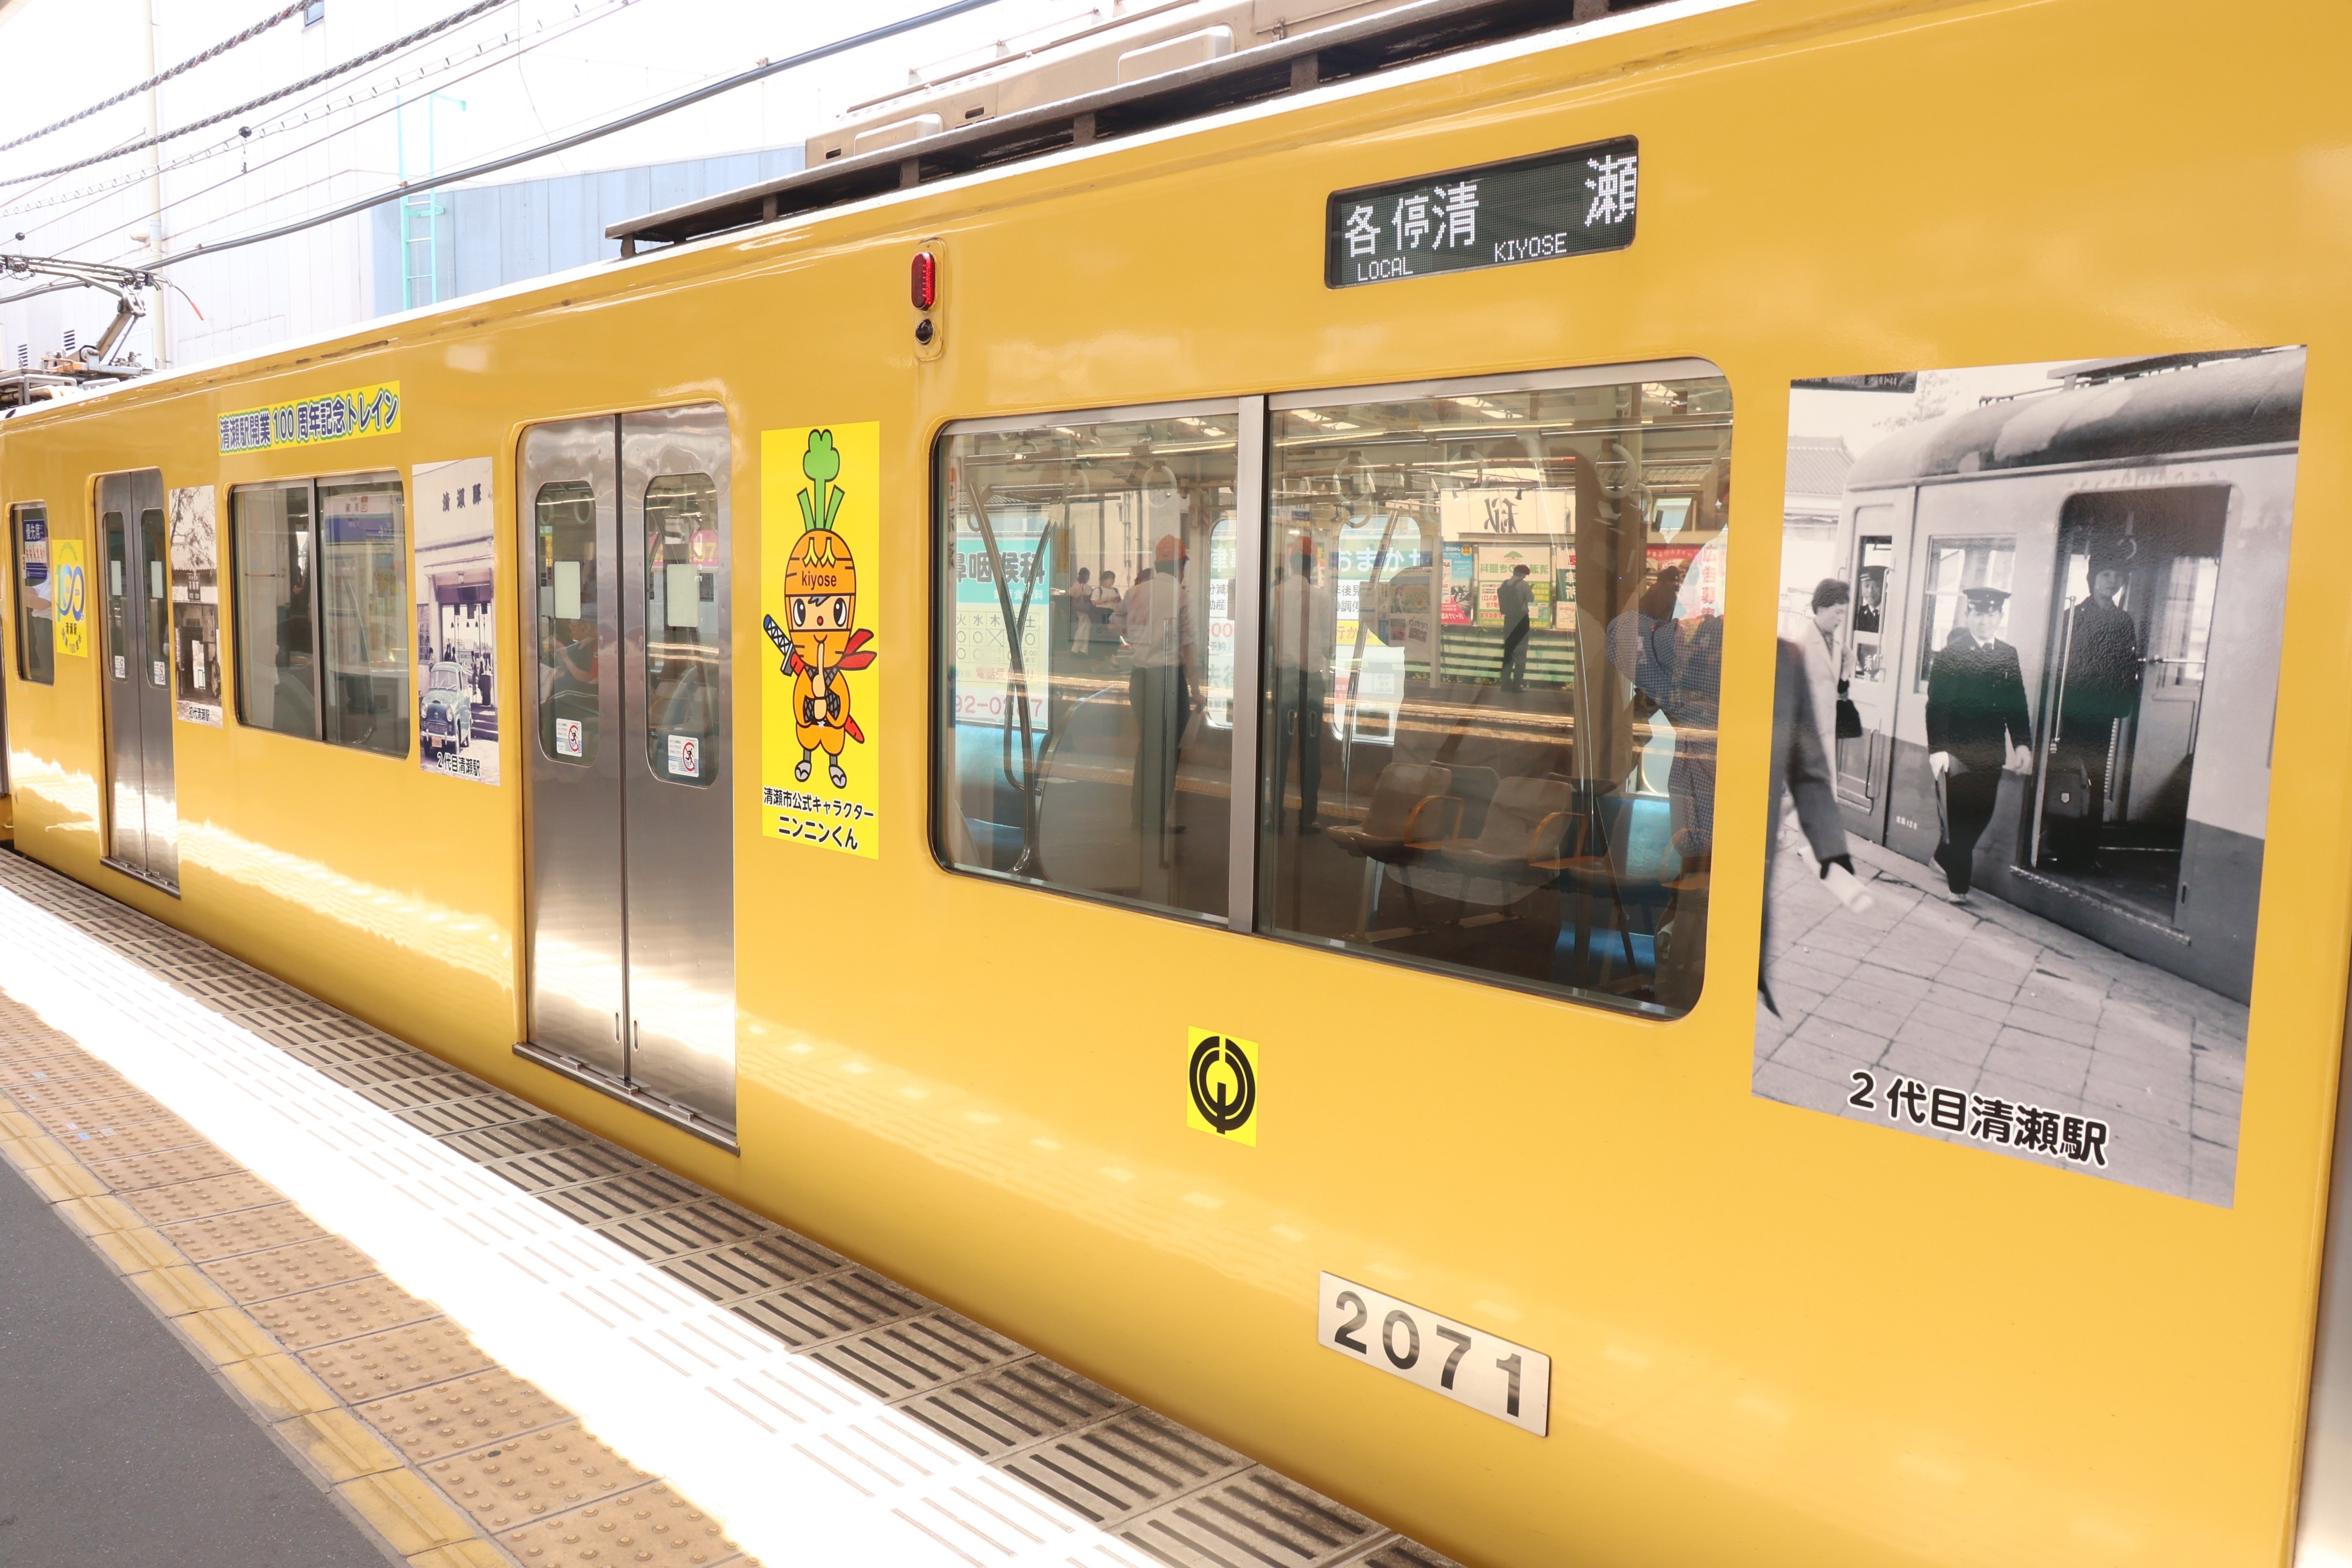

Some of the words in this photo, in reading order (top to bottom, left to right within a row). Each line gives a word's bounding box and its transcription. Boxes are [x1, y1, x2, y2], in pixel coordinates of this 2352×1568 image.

[1345, 195, 1429, 257] 各停
[1494, 233, 1567, 262] KIYOSE
[1358, 257, 1413, 281] LOCAL
[801, 571, 837, 590] kiyose
[973, 614, 983, 626] 水
[990, 614, 1000, 626] 木
[1025, 615, 1035, 628] 土
[956, 695, 1043, 718] 92-07
[438, 753, 480, 777] 2代目清瀬駅
[764, 787, 874, 820] 清瀬市公式キャラクター
[779, 816, 858, 850] ニンニンくん
[1849, 1072, 2107, 1166] 2代目清瀬駅
[1334, 1290, 1522, 1418] 2071
